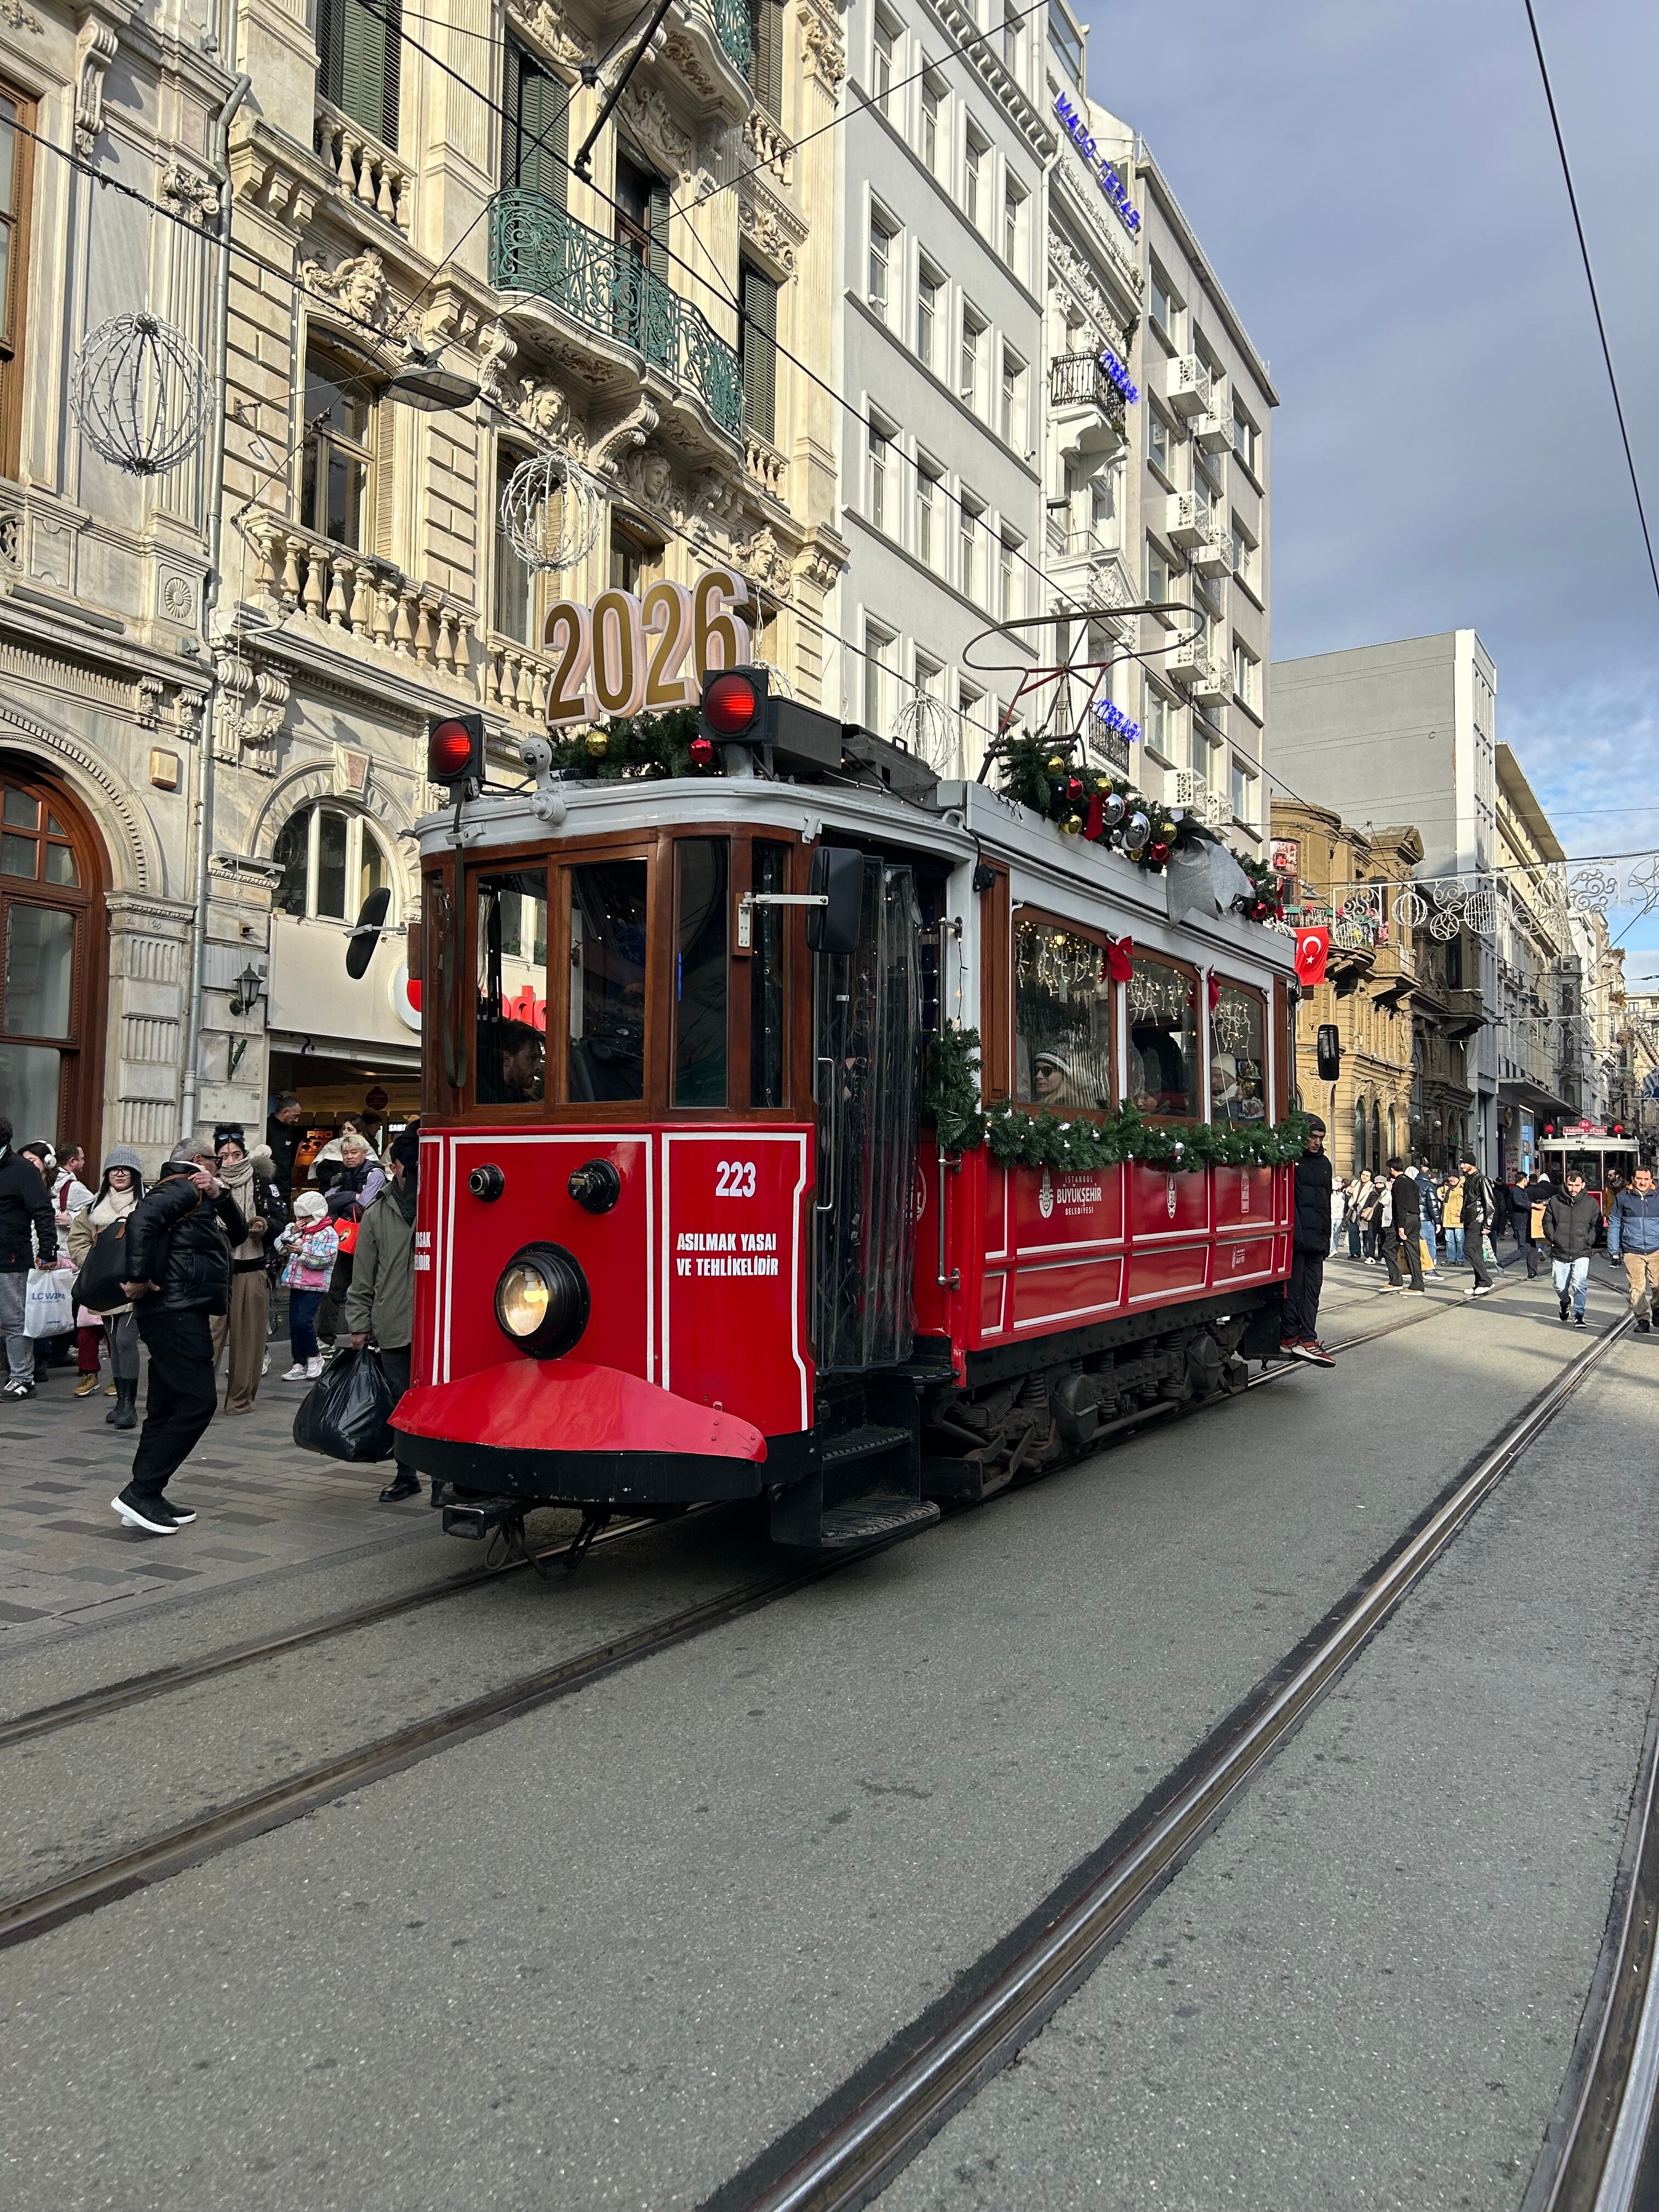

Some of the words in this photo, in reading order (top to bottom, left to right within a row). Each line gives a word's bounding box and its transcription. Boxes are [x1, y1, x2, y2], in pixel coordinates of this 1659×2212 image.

[1053, 91, 1096, 158] MADO
[1097, 159, 1141, 228] TERAS
[543, 567, 749, 726] 2026
[715, 1161, 756, 1197] 223
[1057, 1183, 1102, 1207] BÜYÜKŞEHİR
[1065, 1204, 1093, 1215] BELEDİYESİ
[676, 1233, 737, 1251] ASILMAK
[676, 1259, 692, 1276] VE
[696, 1255, 778, 1276] TEHLİKELİDİR
[32, 1292, 44, 1300] LC
